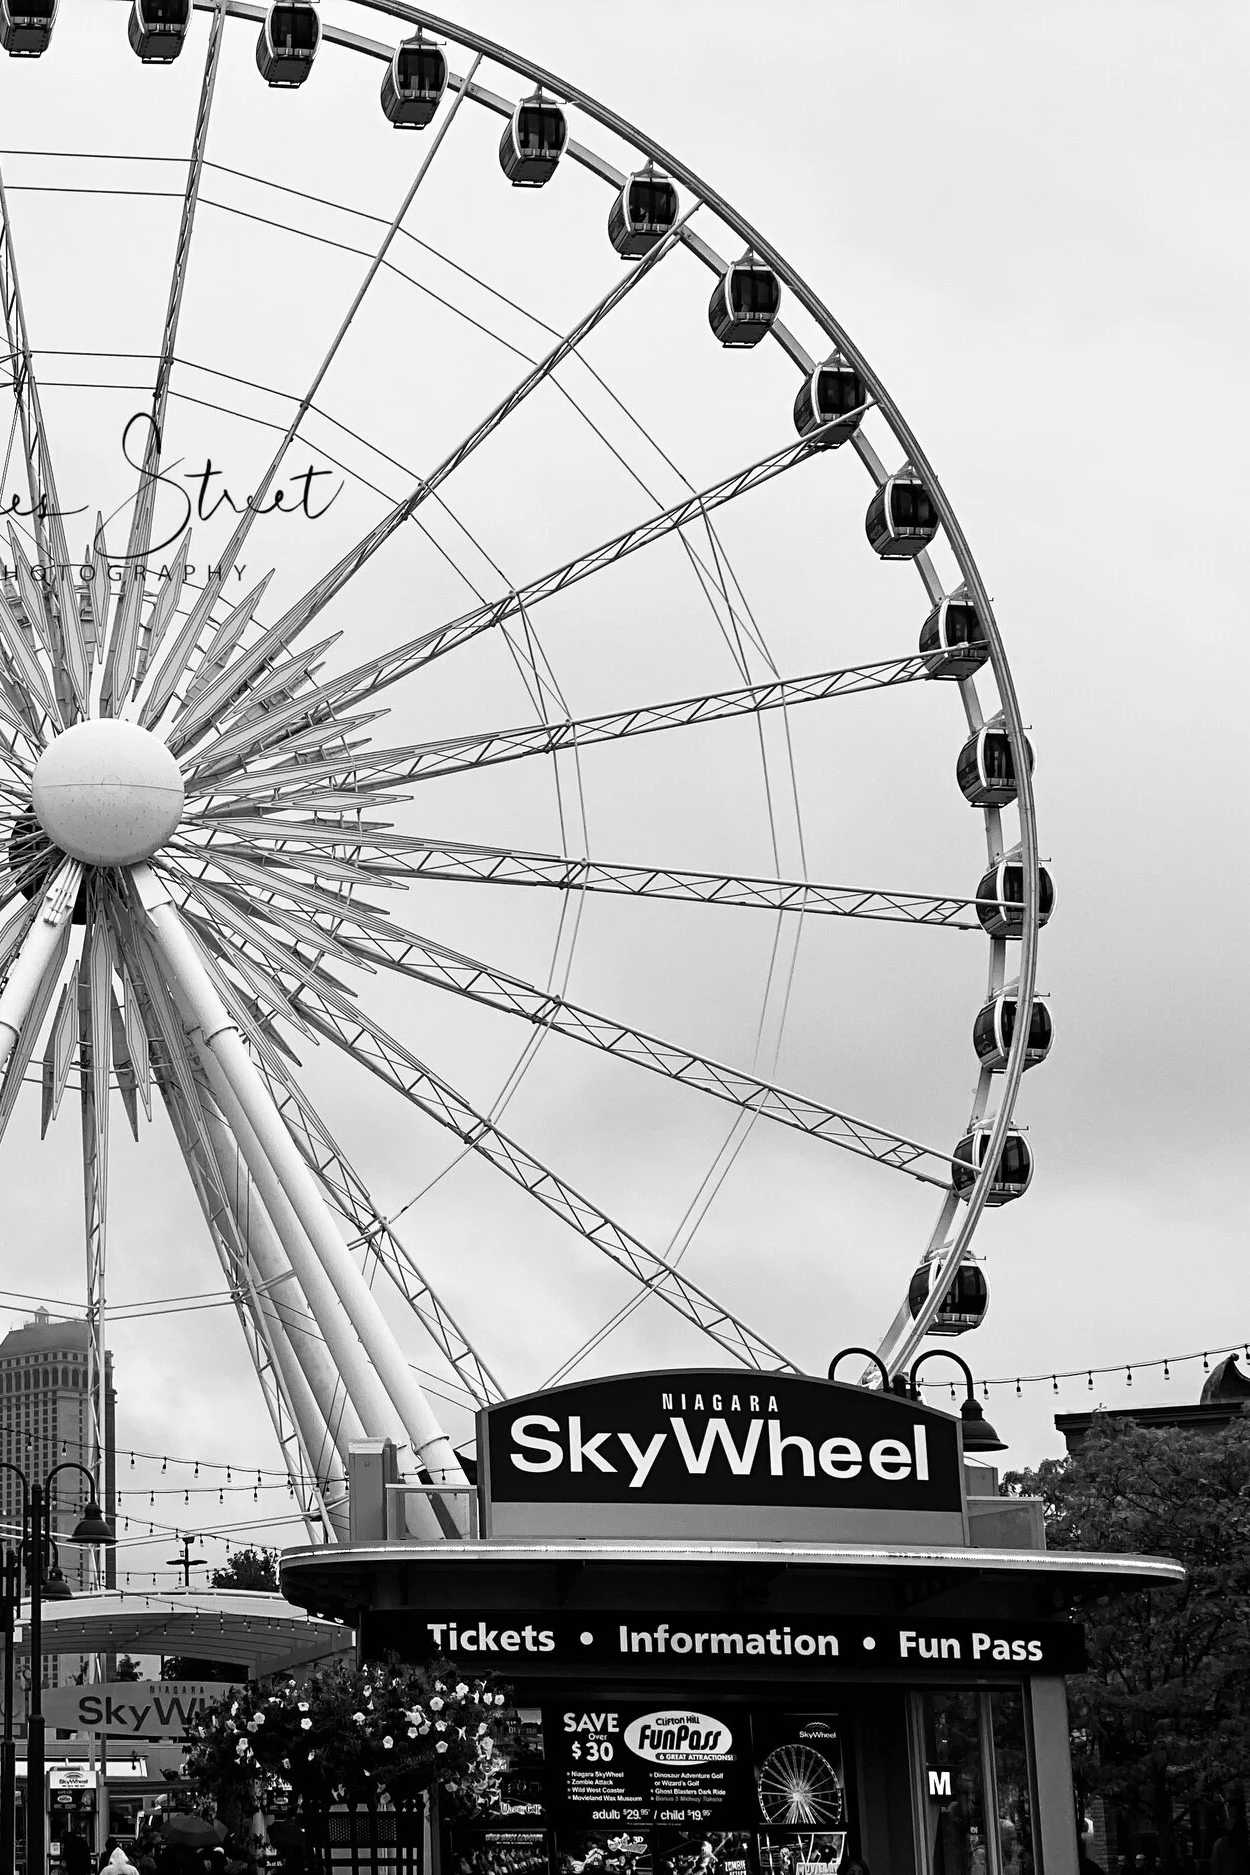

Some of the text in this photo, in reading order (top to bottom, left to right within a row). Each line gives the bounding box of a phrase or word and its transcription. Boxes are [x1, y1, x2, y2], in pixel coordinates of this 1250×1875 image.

[662, 1393, 779, 1412] NIAGARA
[510, 1414, 930, 1488] SkyWheel
[427, 1622, 1043, 1661] Tickets Information Fun Pass
[150, 1686, 205, 1694] NIAGARA
[563, 1713, 620, 1732] SAVE
[656, 1715, 700, 1726] Clifton Hill
[588, 1733, 608, 1741] Over
[638, 1725, 722, 1751] FunPass
[799, 1731, 837, 1739] SkyWheel
[592, 1809, 620, 1820] adult
[660, 1810, 685, 1820] child
[633, 1836, 644, 1844] 3D
